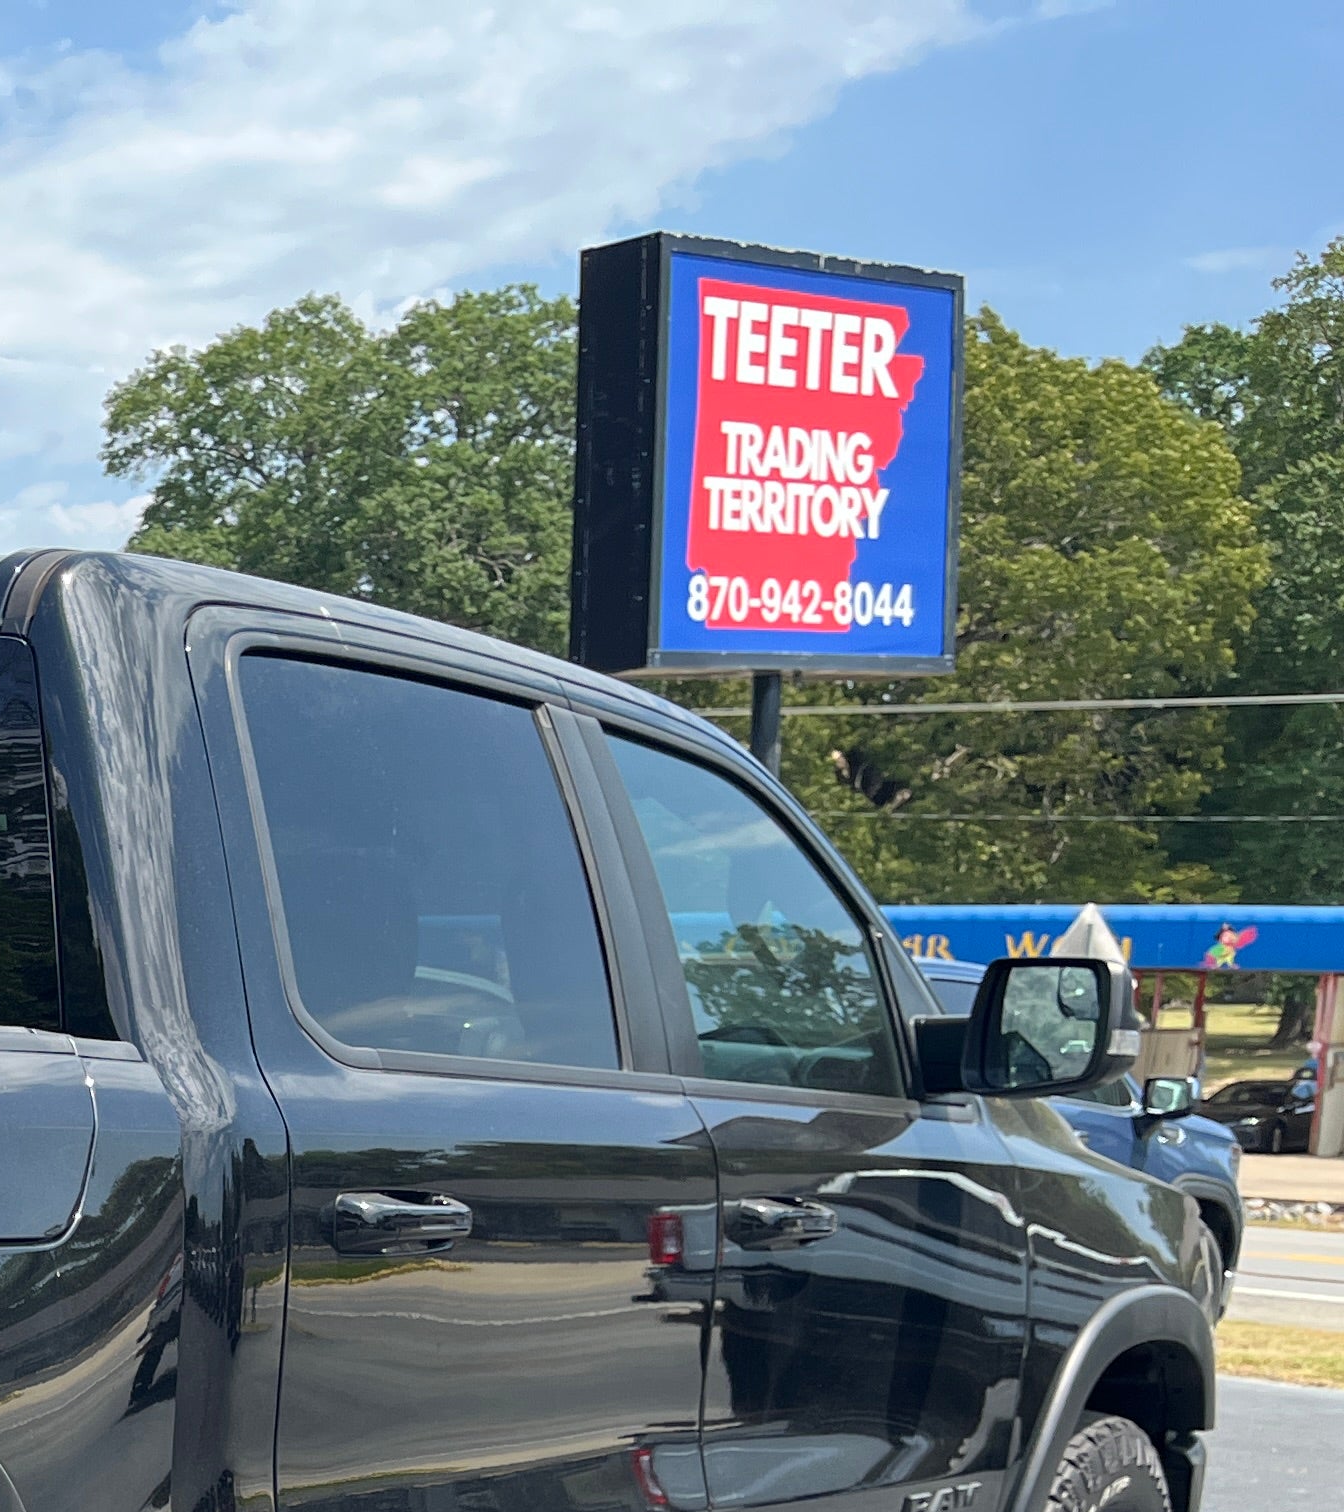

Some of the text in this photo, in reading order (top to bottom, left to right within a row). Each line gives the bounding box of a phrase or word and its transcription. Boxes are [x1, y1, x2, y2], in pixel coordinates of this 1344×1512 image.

[703, 295, 900, 399] TEETER
[721, 420, 875, 484] TRADING
[703, 476, 891, 540] TERRITORY
[686, 574, 915, 628] 870-942-8044
[902, 932, 955, 961] AR
